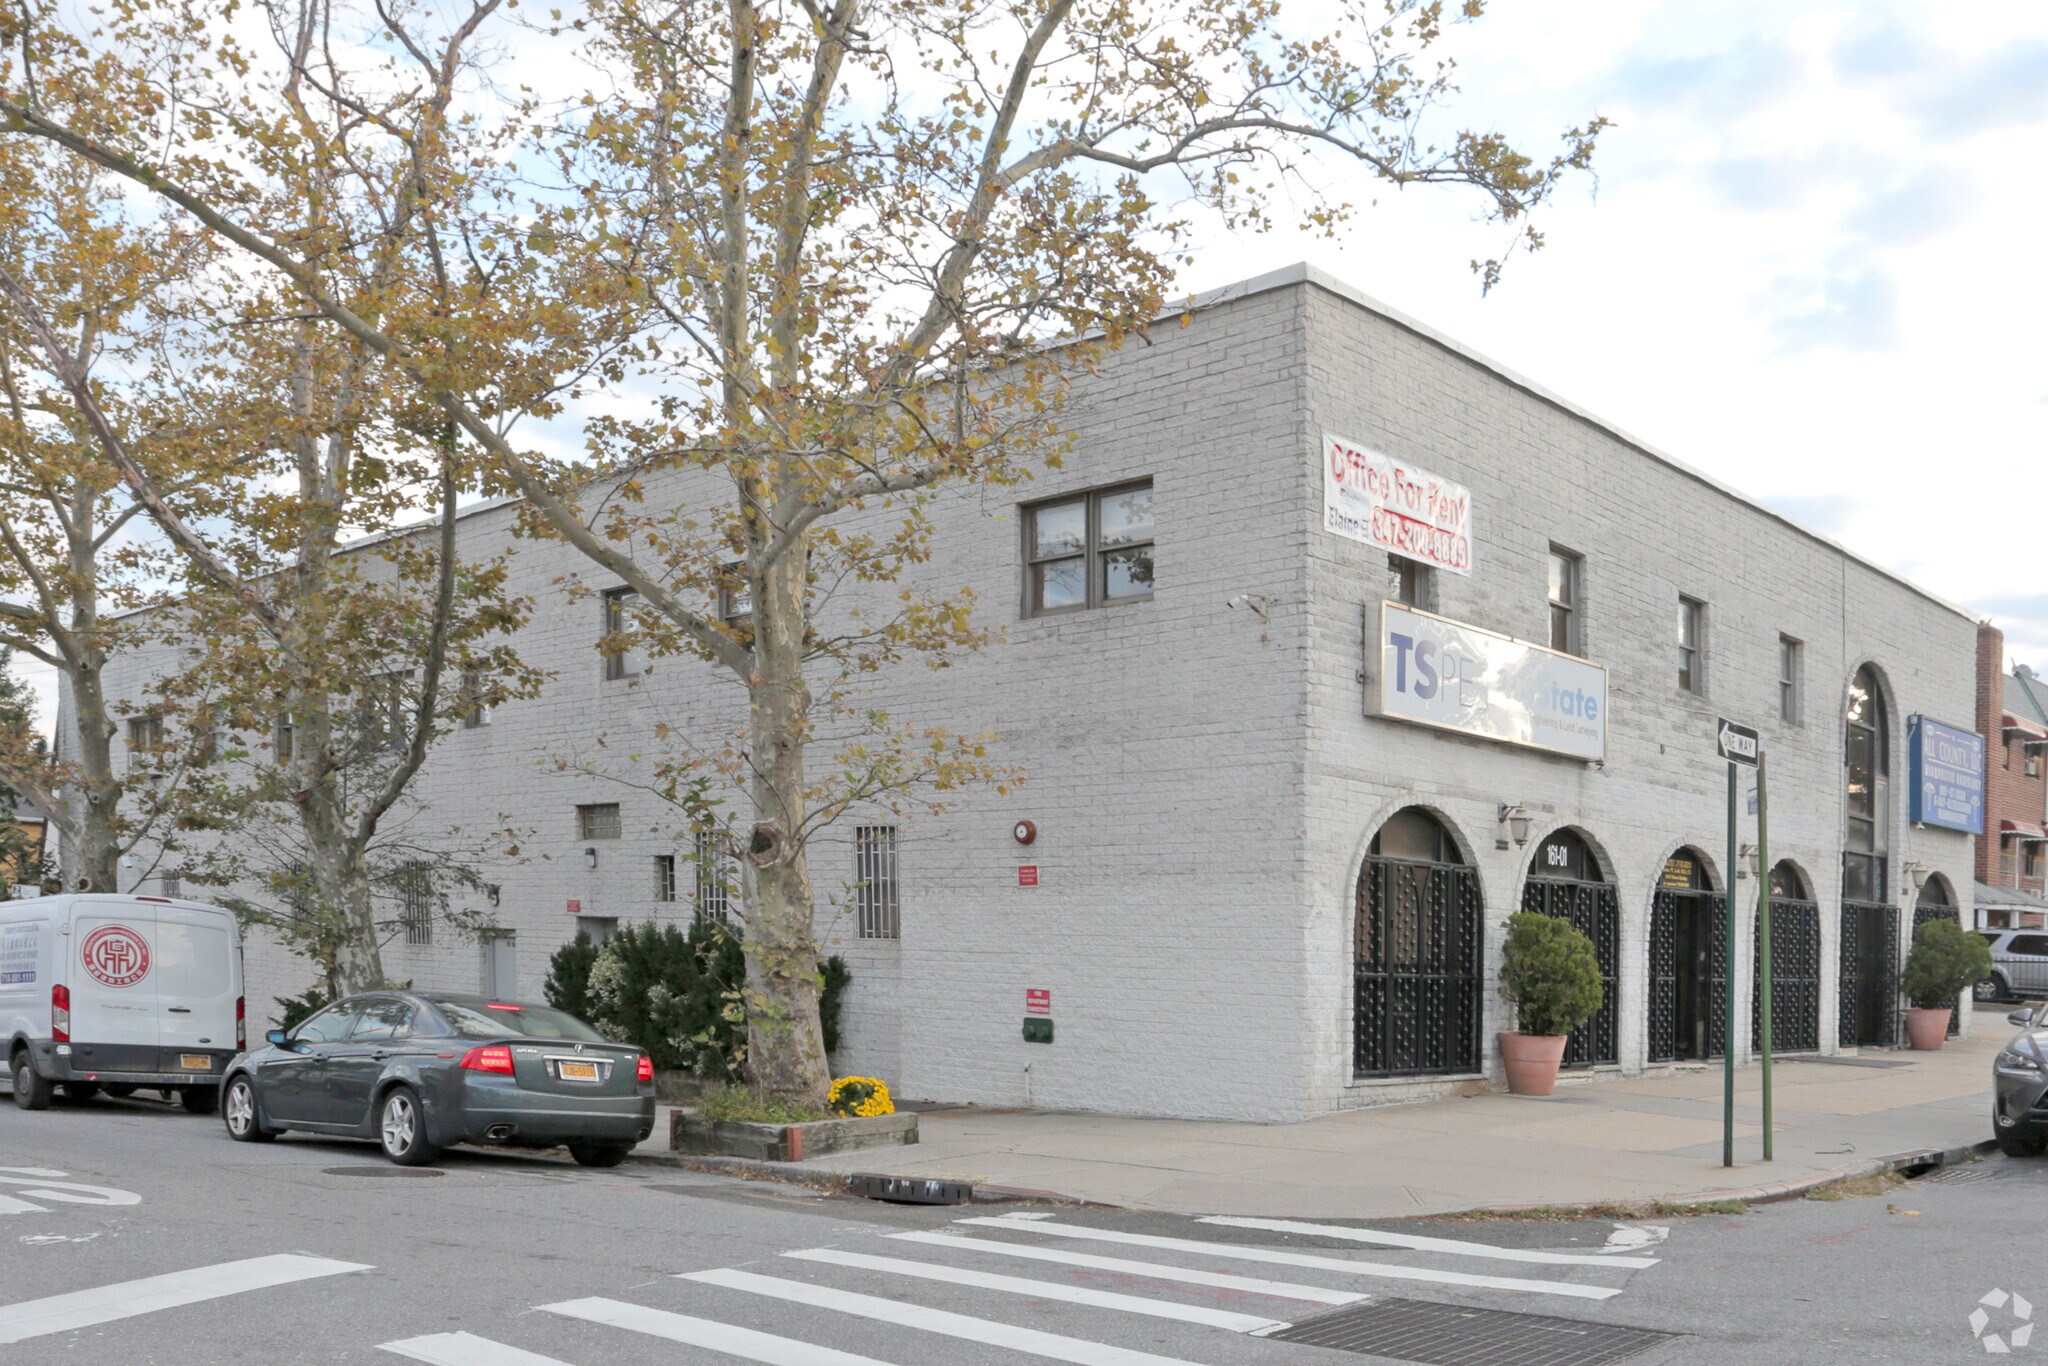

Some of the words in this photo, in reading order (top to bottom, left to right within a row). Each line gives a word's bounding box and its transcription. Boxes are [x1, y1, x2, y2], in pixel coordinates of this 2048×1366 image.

[1331, 444, 1389, 500] Office
[1395, 468, 1424, 511] For
[1428, 481, 1466, 529] Rent
[1328, 506, 1359, 534] Elaine
[1724, 731, 1736, 750] ONE
[1738, 736, 1754, 755] WAY
[1924, 737, 1936, 758] ALL
[1970, 751, 1982, 773] LLC
[1547, 844, 1568, 867] 161-01
